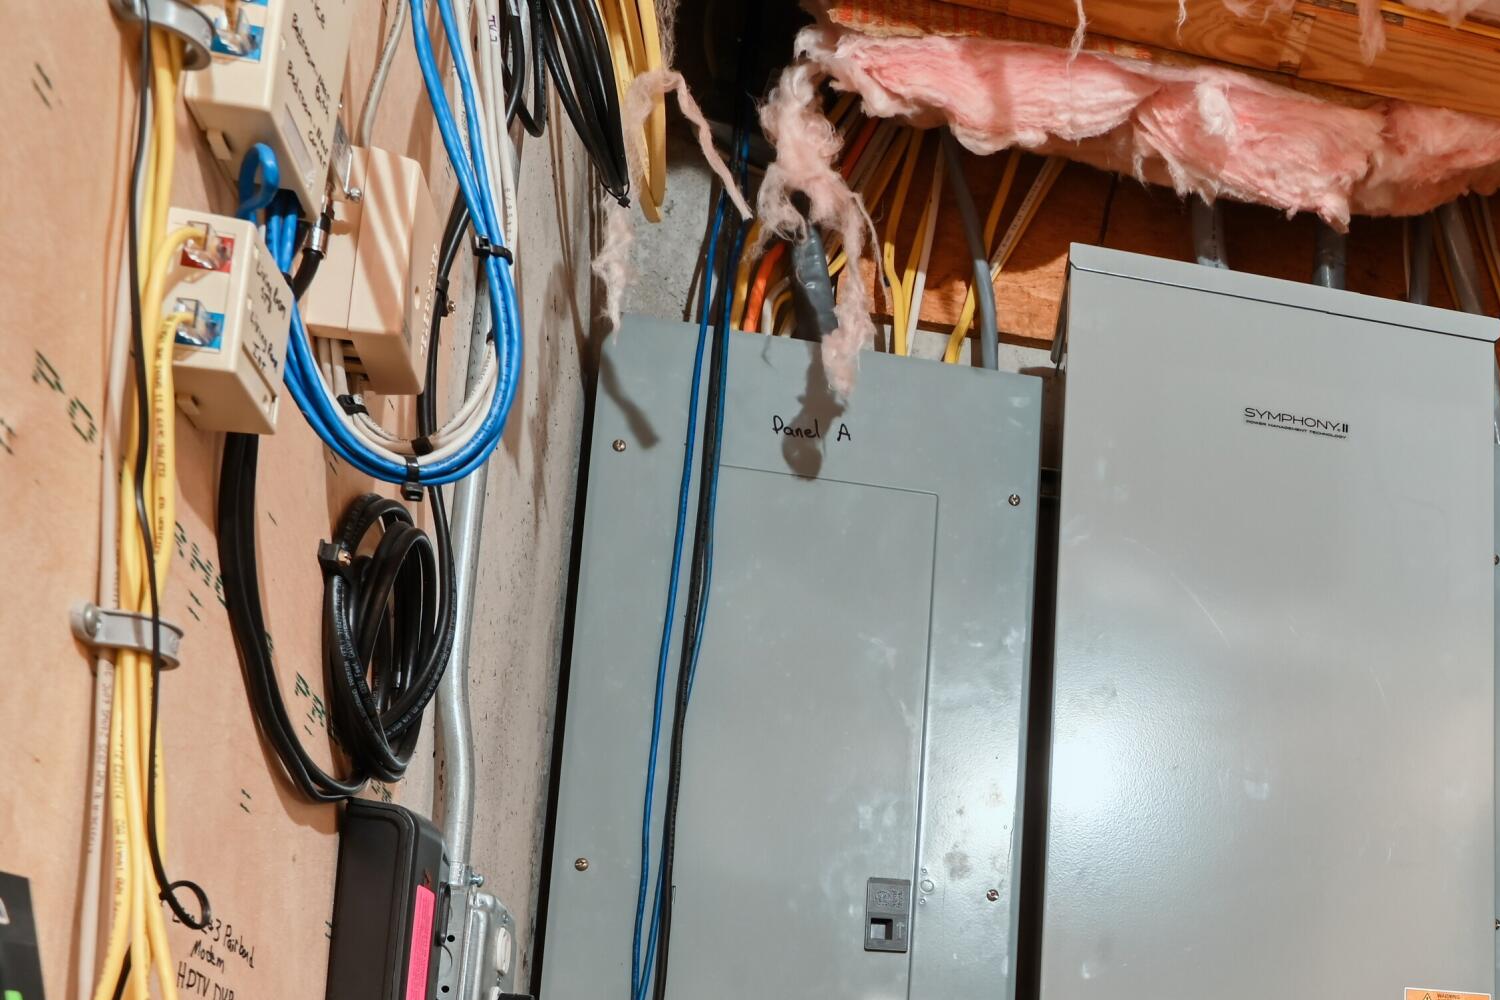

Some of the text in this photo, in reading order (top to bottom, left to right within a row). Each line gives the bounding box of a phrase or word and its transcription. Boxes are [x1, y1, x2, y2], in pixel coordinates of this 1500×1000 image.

[772, 415, 852, 442] Panel A
[1246, 419, 1347, 439] POWER MANAGEMENT TECHNOLOGY
[189, 939, 225, 975] Modem
[176, 960, 211, 998] HDTV
